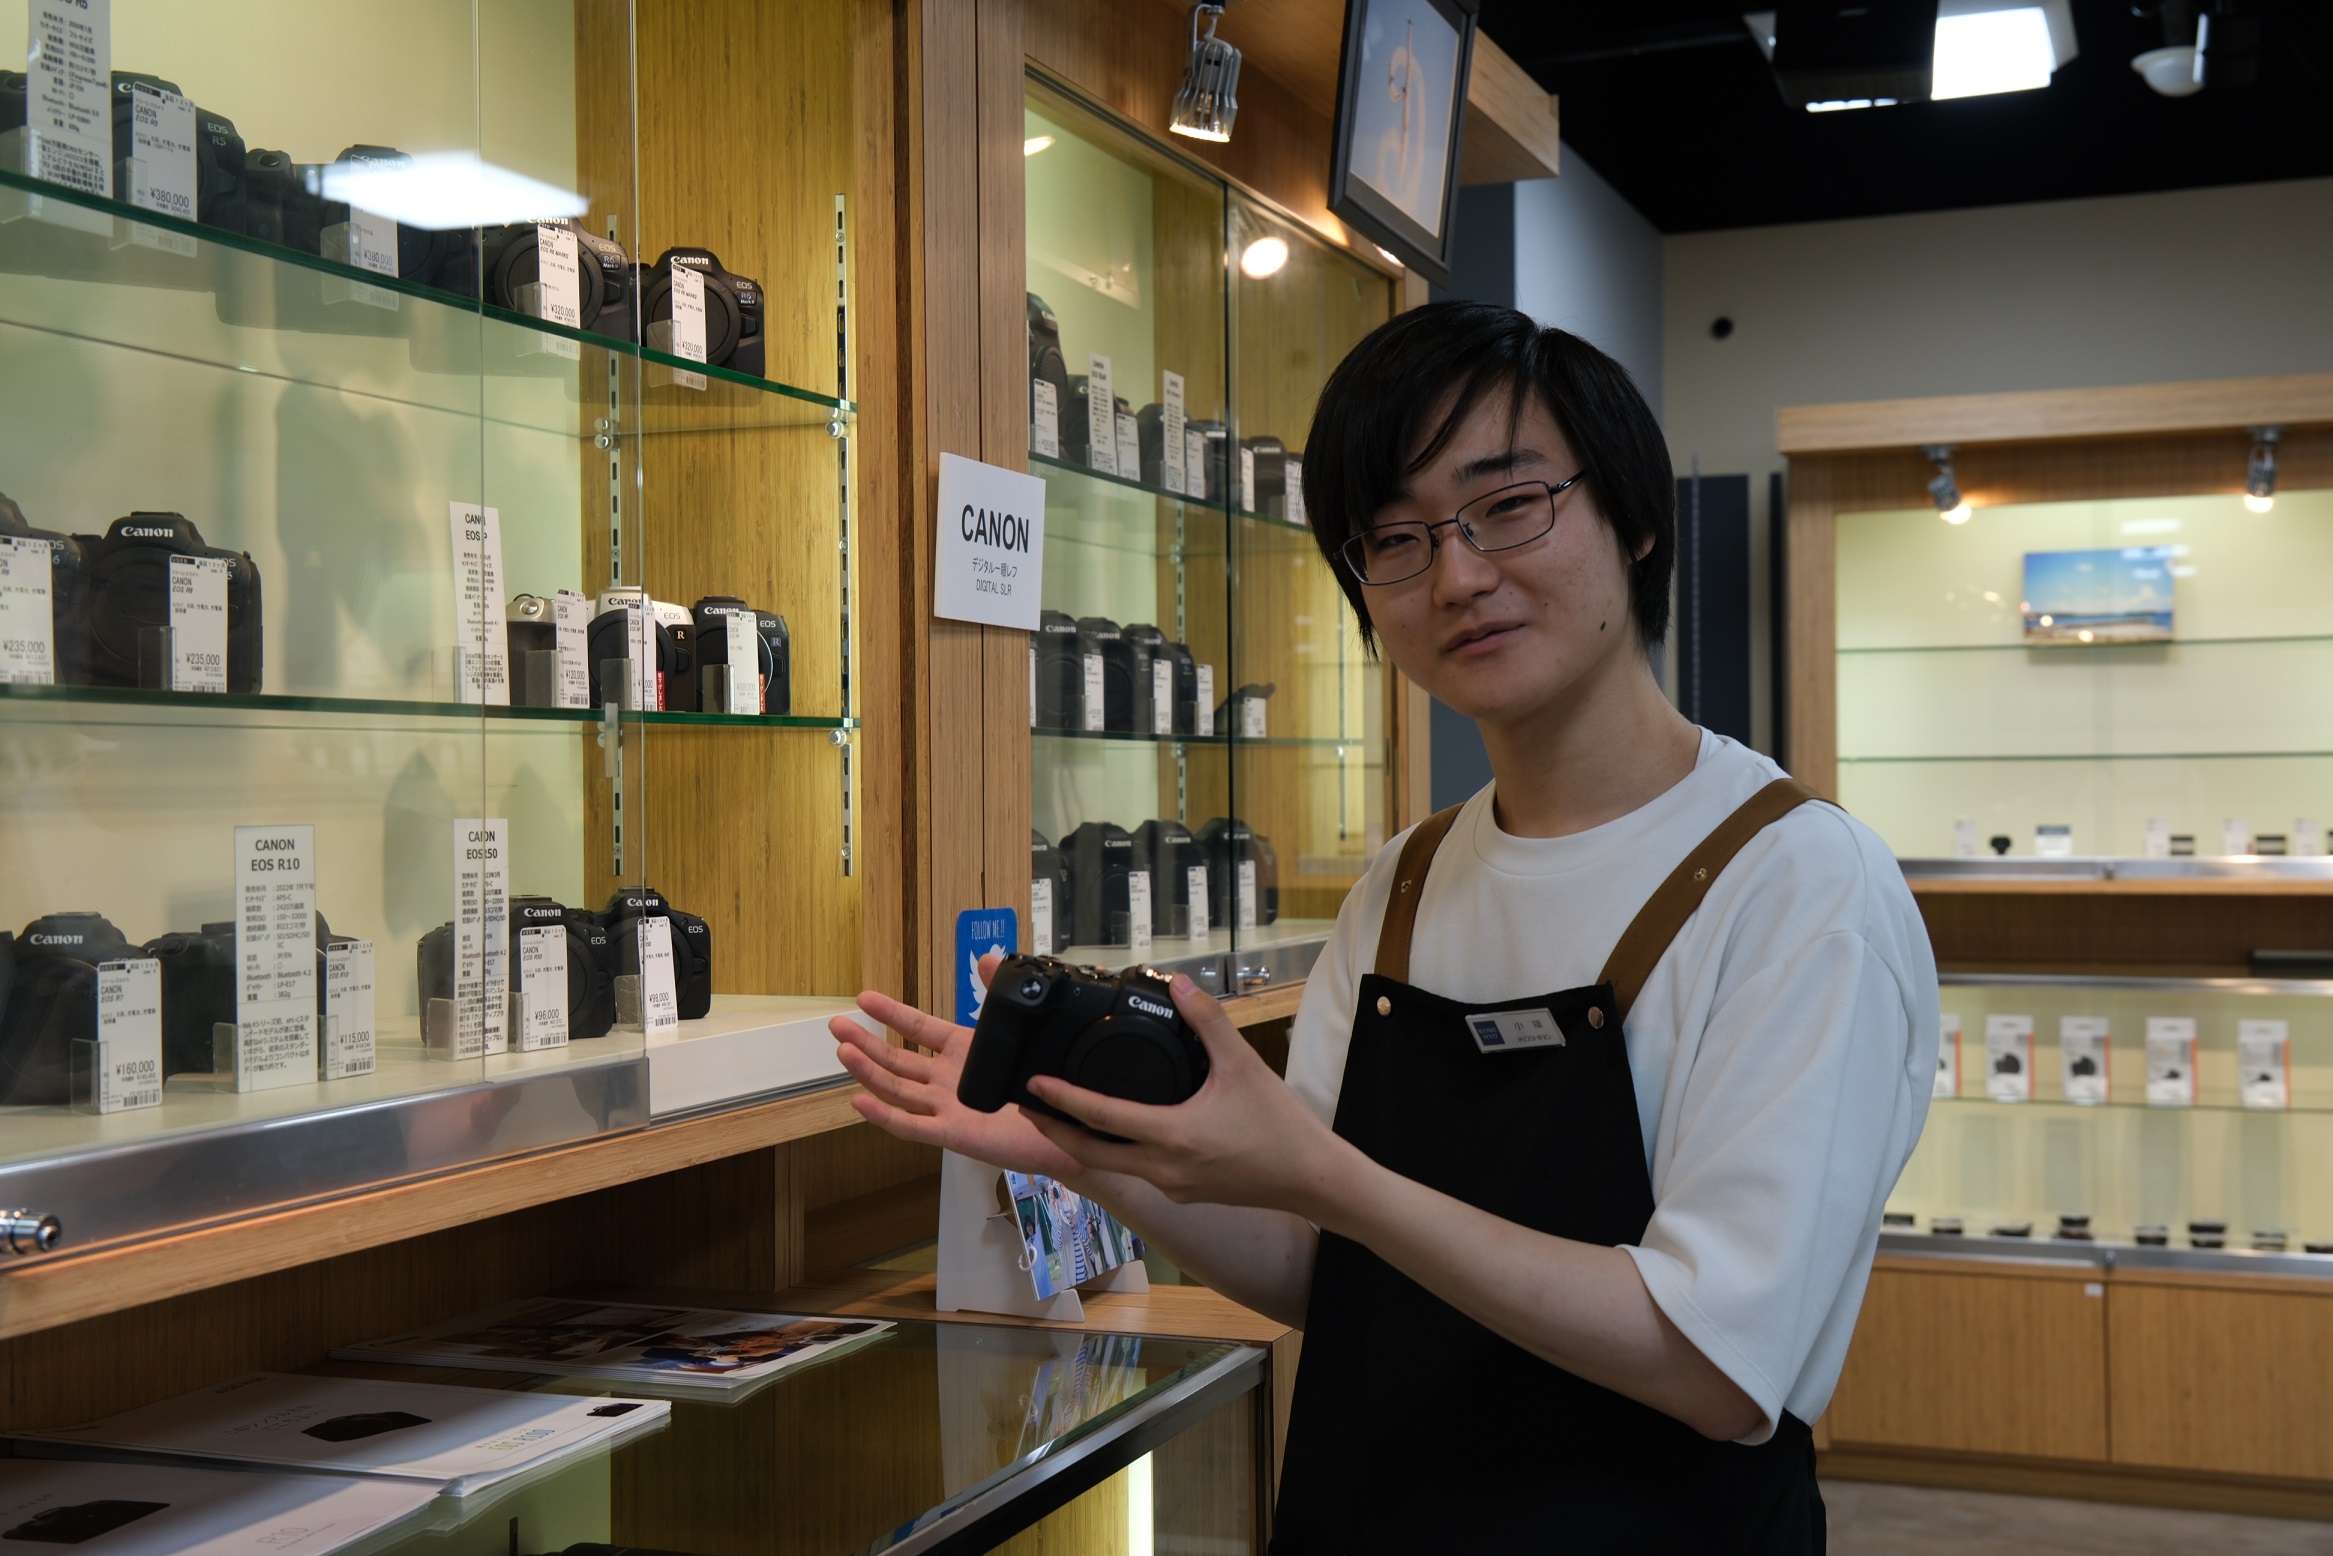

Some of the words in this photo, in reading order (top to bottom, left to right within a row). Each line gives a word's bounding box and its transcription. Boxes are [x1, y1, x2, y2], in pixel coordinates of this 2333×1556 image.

[135, 104, 157, 118] CANON
[207, 122, 229, 135] EOS
[212, 136, 226, 146] R5
[150, 186, 189, 208] ¥380,000
[598, 243, 616, 252] EOS
[603, 255, 615, 263] R6
[670, 255, 709, 265] Canon
[736, 281, 753, 289] EOS
[741, 292, 752, 300] R6
[550, 303, 576, 318] ¥320,000
[120, 525, 174, 538] Canon
[961, 504, 1030, 553] CANON
[465, 530, 481, 541] EOS
[971, 557, 1018, 578] デジタル一眼レフ
[172, 576, 192, 586] CANON
[172, 585, 185, 593] EOS
[976, 578, 999, 594] DIGITAL
[1000, 583, 1012, 596] SLR
[663, 612, 681, 620] EOS
[759, 620, 776, 628] EOS
[1045, 624, 1077, 633] Canon
[676, 630, 685, 640] R
[1095, 631, 1121, 640] anon
[2, 639, 45, 654] ¥235,000
[772, 637, 780, 647] R
[186, 652, 220, 666] ¥235,000
[255, 838, 295, 851] CANON
[1104, 839, 1132, 848] Canon
[1165, 836, 1192, 844] Canon
[466, 849, 482, 859] EOS
[251, 859, 274, 871] EOS
[278, 858, 300, 870] R10
[627, 897, 659, 907] Caon
[524, 907, 562, 917] Canon
[688, 925, 704, 933] EOS
[971, 920, 991, 940] FOLLOW
[993, 920, 1000, 938] ME
[30, 932, 84, 945] Canon
[590, 936, 607, 945] EOS
[522, 946, 539, 955] CANON
[328, 963, 346, 972] CANON
[277, 971, 301, 979] Bluetooth
[100, 984, 122, 995] CANON
[101, 995, 115, 1003] EOS
[1128, 995, 1174, 1019] Canon
[535, 1008, 560, 1021] ¥96,000
[340, 1031, 369, 1044] ¥115,000
[116, 1060, 154, 1075] ¥160,000
[255, 1527, 309, 1544] R10
